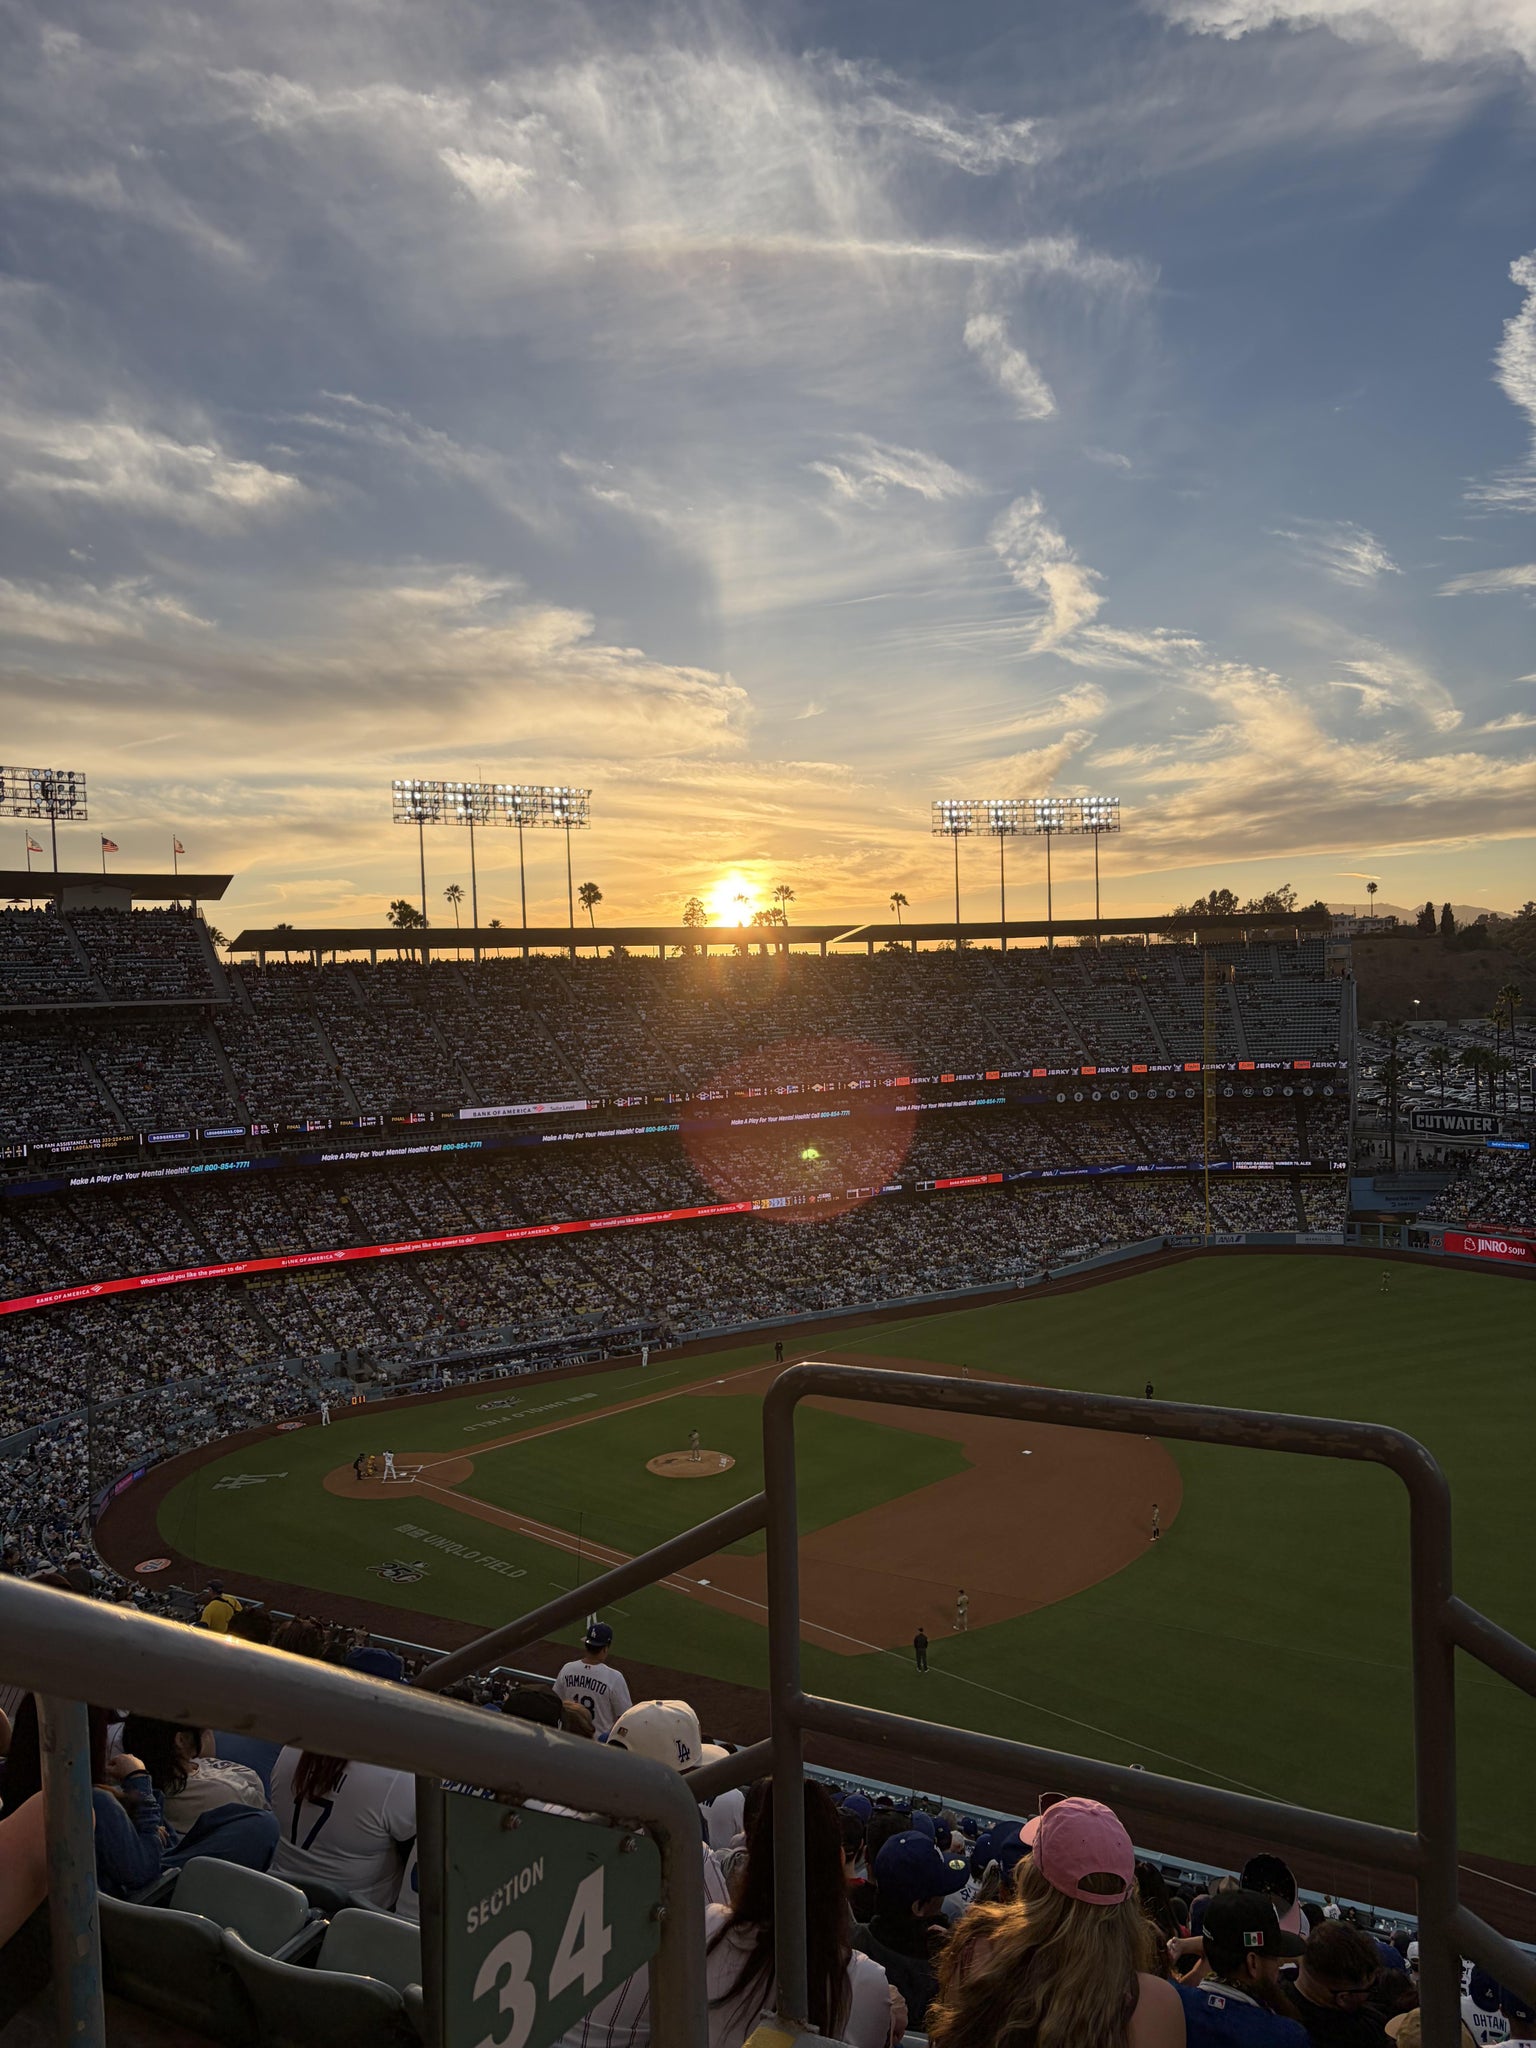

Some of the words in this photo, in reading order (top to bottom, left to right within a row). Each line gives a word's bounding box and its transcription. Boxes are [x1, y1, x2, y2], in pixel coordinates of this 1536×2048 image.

[1416, 1115, 1492, 1131] CUTWATER
[386, 1147, 406, 1156] Mental
[70, 1177, 88, 1186] Make
[96, 1175, 111, 1183] Play
[125, 1172, 140, 1180] Your
[141, 1169, 165, 1177] Mental
[165, 1166, 189, 1175] Health!
[1431, 1238, 1442, 1246] 76
[1477, 1238, 1507, 1253] JINRO
[1508, 1247, 1525, 1255] SOJU
[308, 1254, 333, 1262] AMERICA
[157, 1275, 174, 1283] would
[36, 1296, 53, 1304] BANK
[63, 1289, 89, 1299] AMERICA
[512, 1401, 569, 1418] UNIQLO
[463, 1417, 512, 1432] FIELD
[423, 1534, 481, 1560] UNIQLO
[474, 1555, 528, 1578] FIELD
[142, 1560, 163, 1571] 76
[565, 1675, 607, 1695] YAMAMOTO
[676, 1740, 690, 1763] LA
[291, 1794, 334, 1850] 17
[466, 1857, 544, 1934] SECTION
[467, 1864, 612, 2048] 34
[1473, 2014, 1507, 2032] OHTANI
